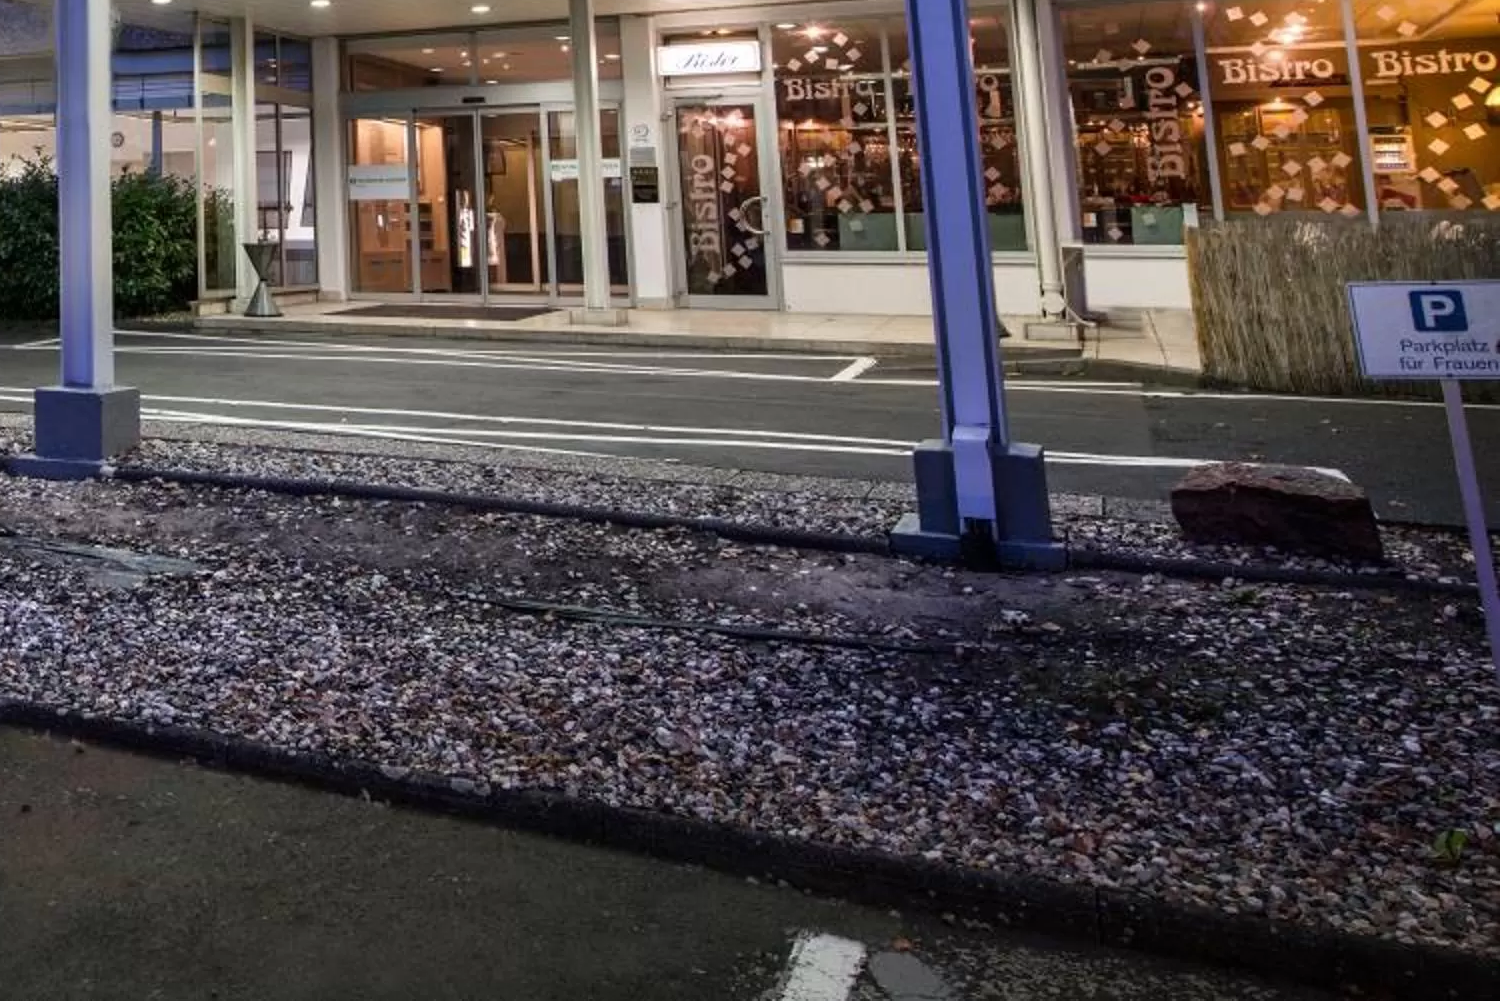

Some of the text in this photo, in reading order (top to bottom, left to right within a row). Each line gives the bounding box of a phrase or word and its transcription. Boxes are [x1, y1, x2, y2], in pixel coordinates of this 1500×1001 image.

[1219, 57, 1334, 84] Bistro
[1370, 49, 1497, 77] Bistro
[1146, 66, 1186, 181] Bistro
[690, 154, 721, 256] Bistro
[1420, 294, 1456, 328] P
[1400, 339, 1490, 355] Parkplatz
[1400, 356, 1500, 370] für Frauen
